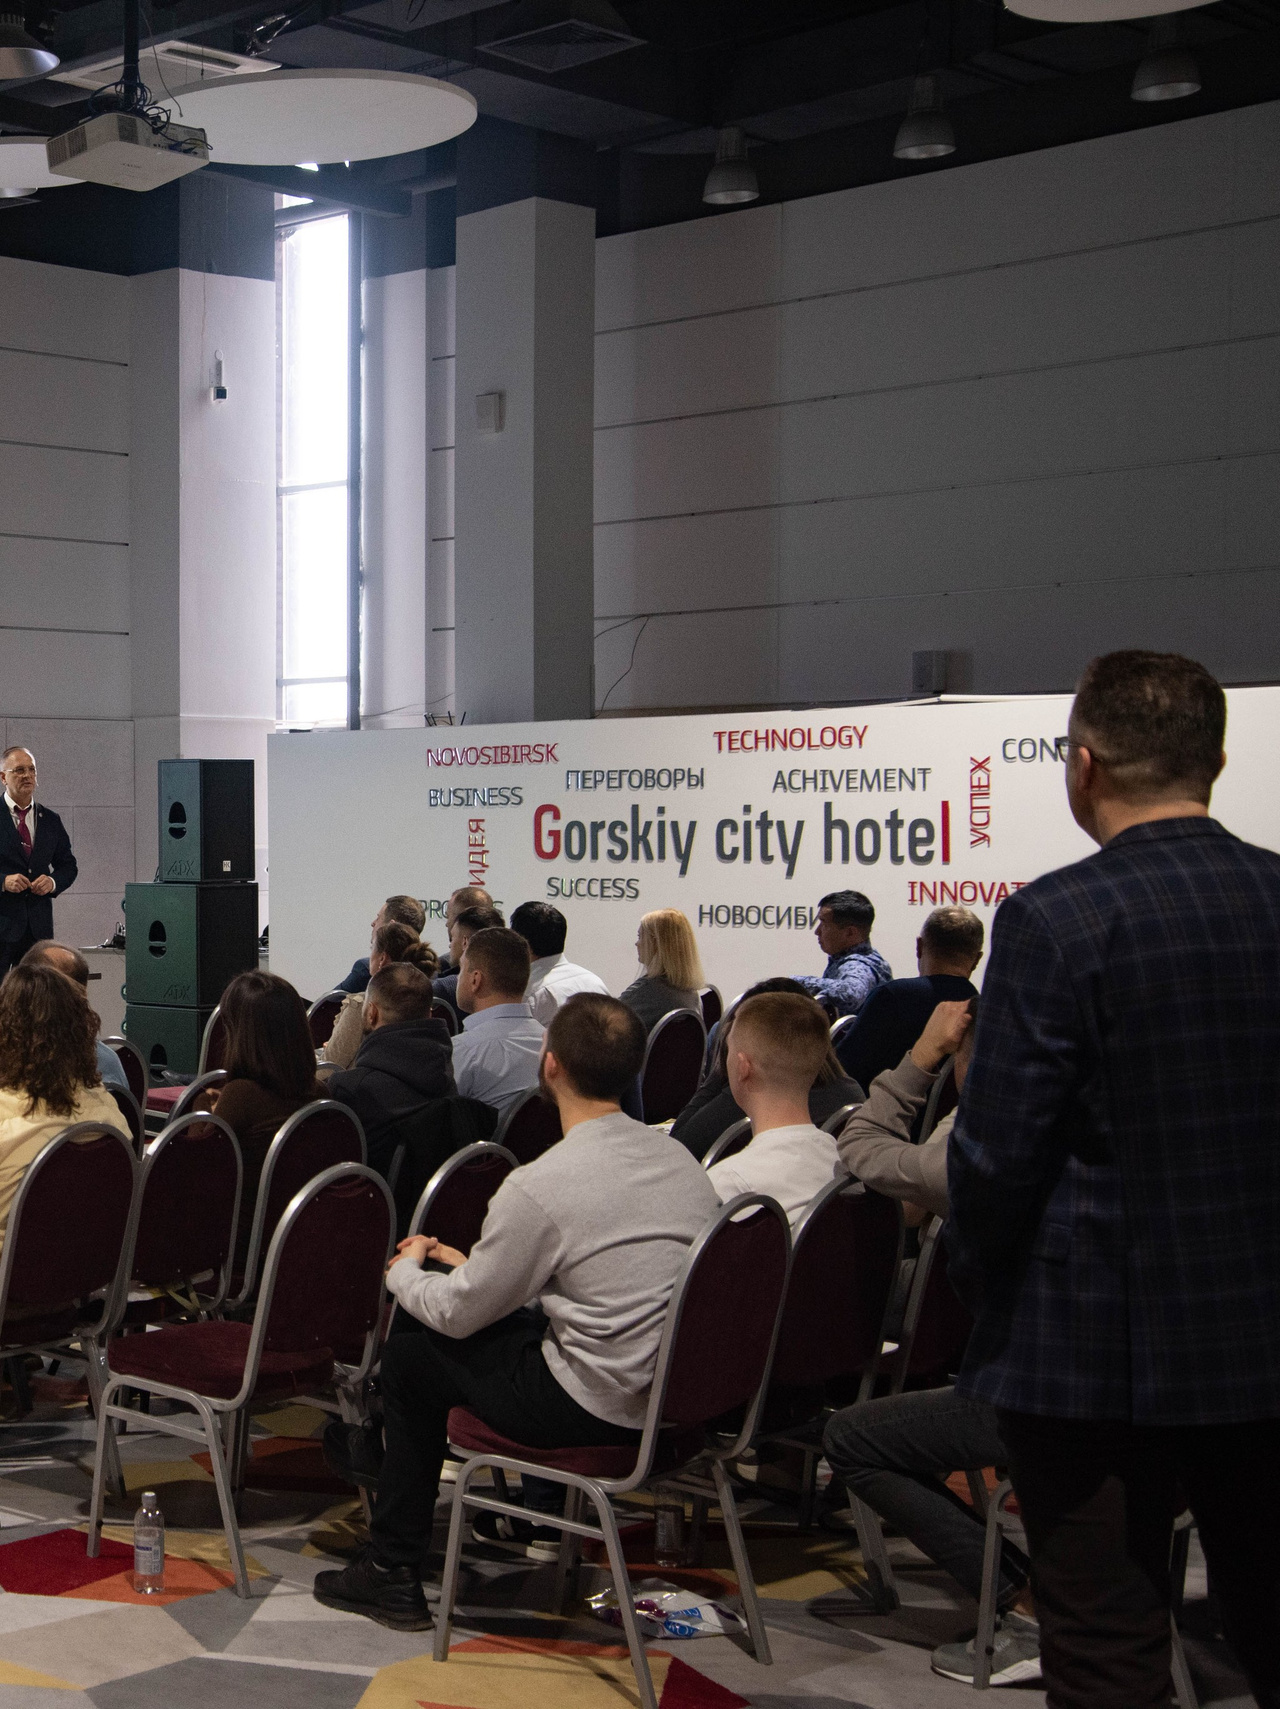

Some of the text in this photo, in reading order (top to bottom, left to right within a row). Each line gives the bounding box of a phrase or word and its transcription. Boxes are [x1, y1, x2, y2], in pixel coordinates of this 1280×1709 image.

[713, 725, 869, 752] TECHNOLOGY
[426, 743, 559, 767] NOVOSIBIRSK
[566, 768, 705, 790] ПЕРЕГОВОРЫ
[772, 767, 932, 793] ACHIVEMENT
[429, 787, 524, 807] BUSINESS
[970, 756, 991, 848] УСПЕХ
[469, 818, 489, 886] ИДЕЯ
[534, 800, 950, 879] Gorskiy city hotel
[547, 877, 639, 900] SUCCESS
[908, 881, 1031, 907] INNOVAT
